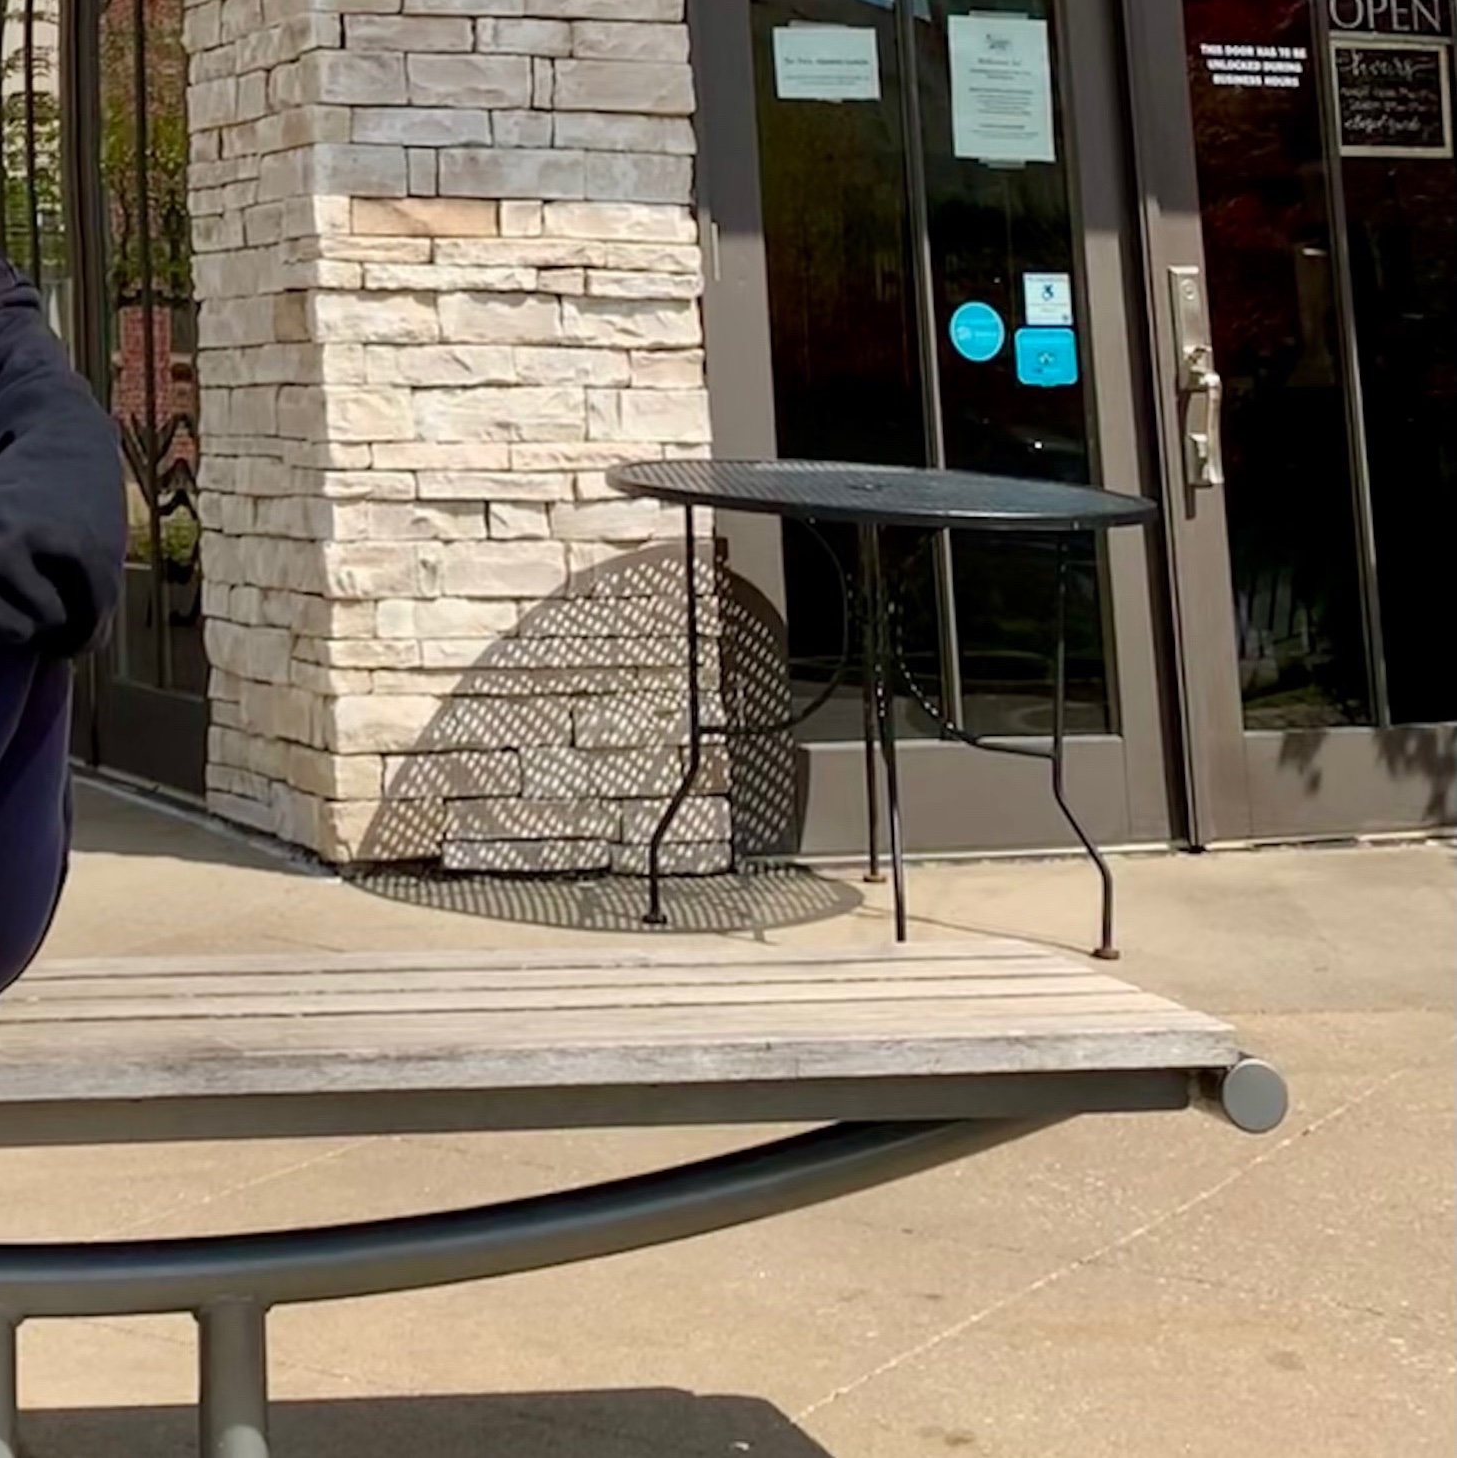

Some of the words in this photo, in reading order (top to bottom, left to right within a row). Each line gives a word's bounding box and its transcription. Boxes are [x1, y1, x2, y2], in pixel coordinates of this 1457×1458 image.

[1224, 45, 1255, 57] DOOR
[1206, 59, 1261, 72] UNLOCKED
[1212, 73, 1262, 86] BUSINESS
